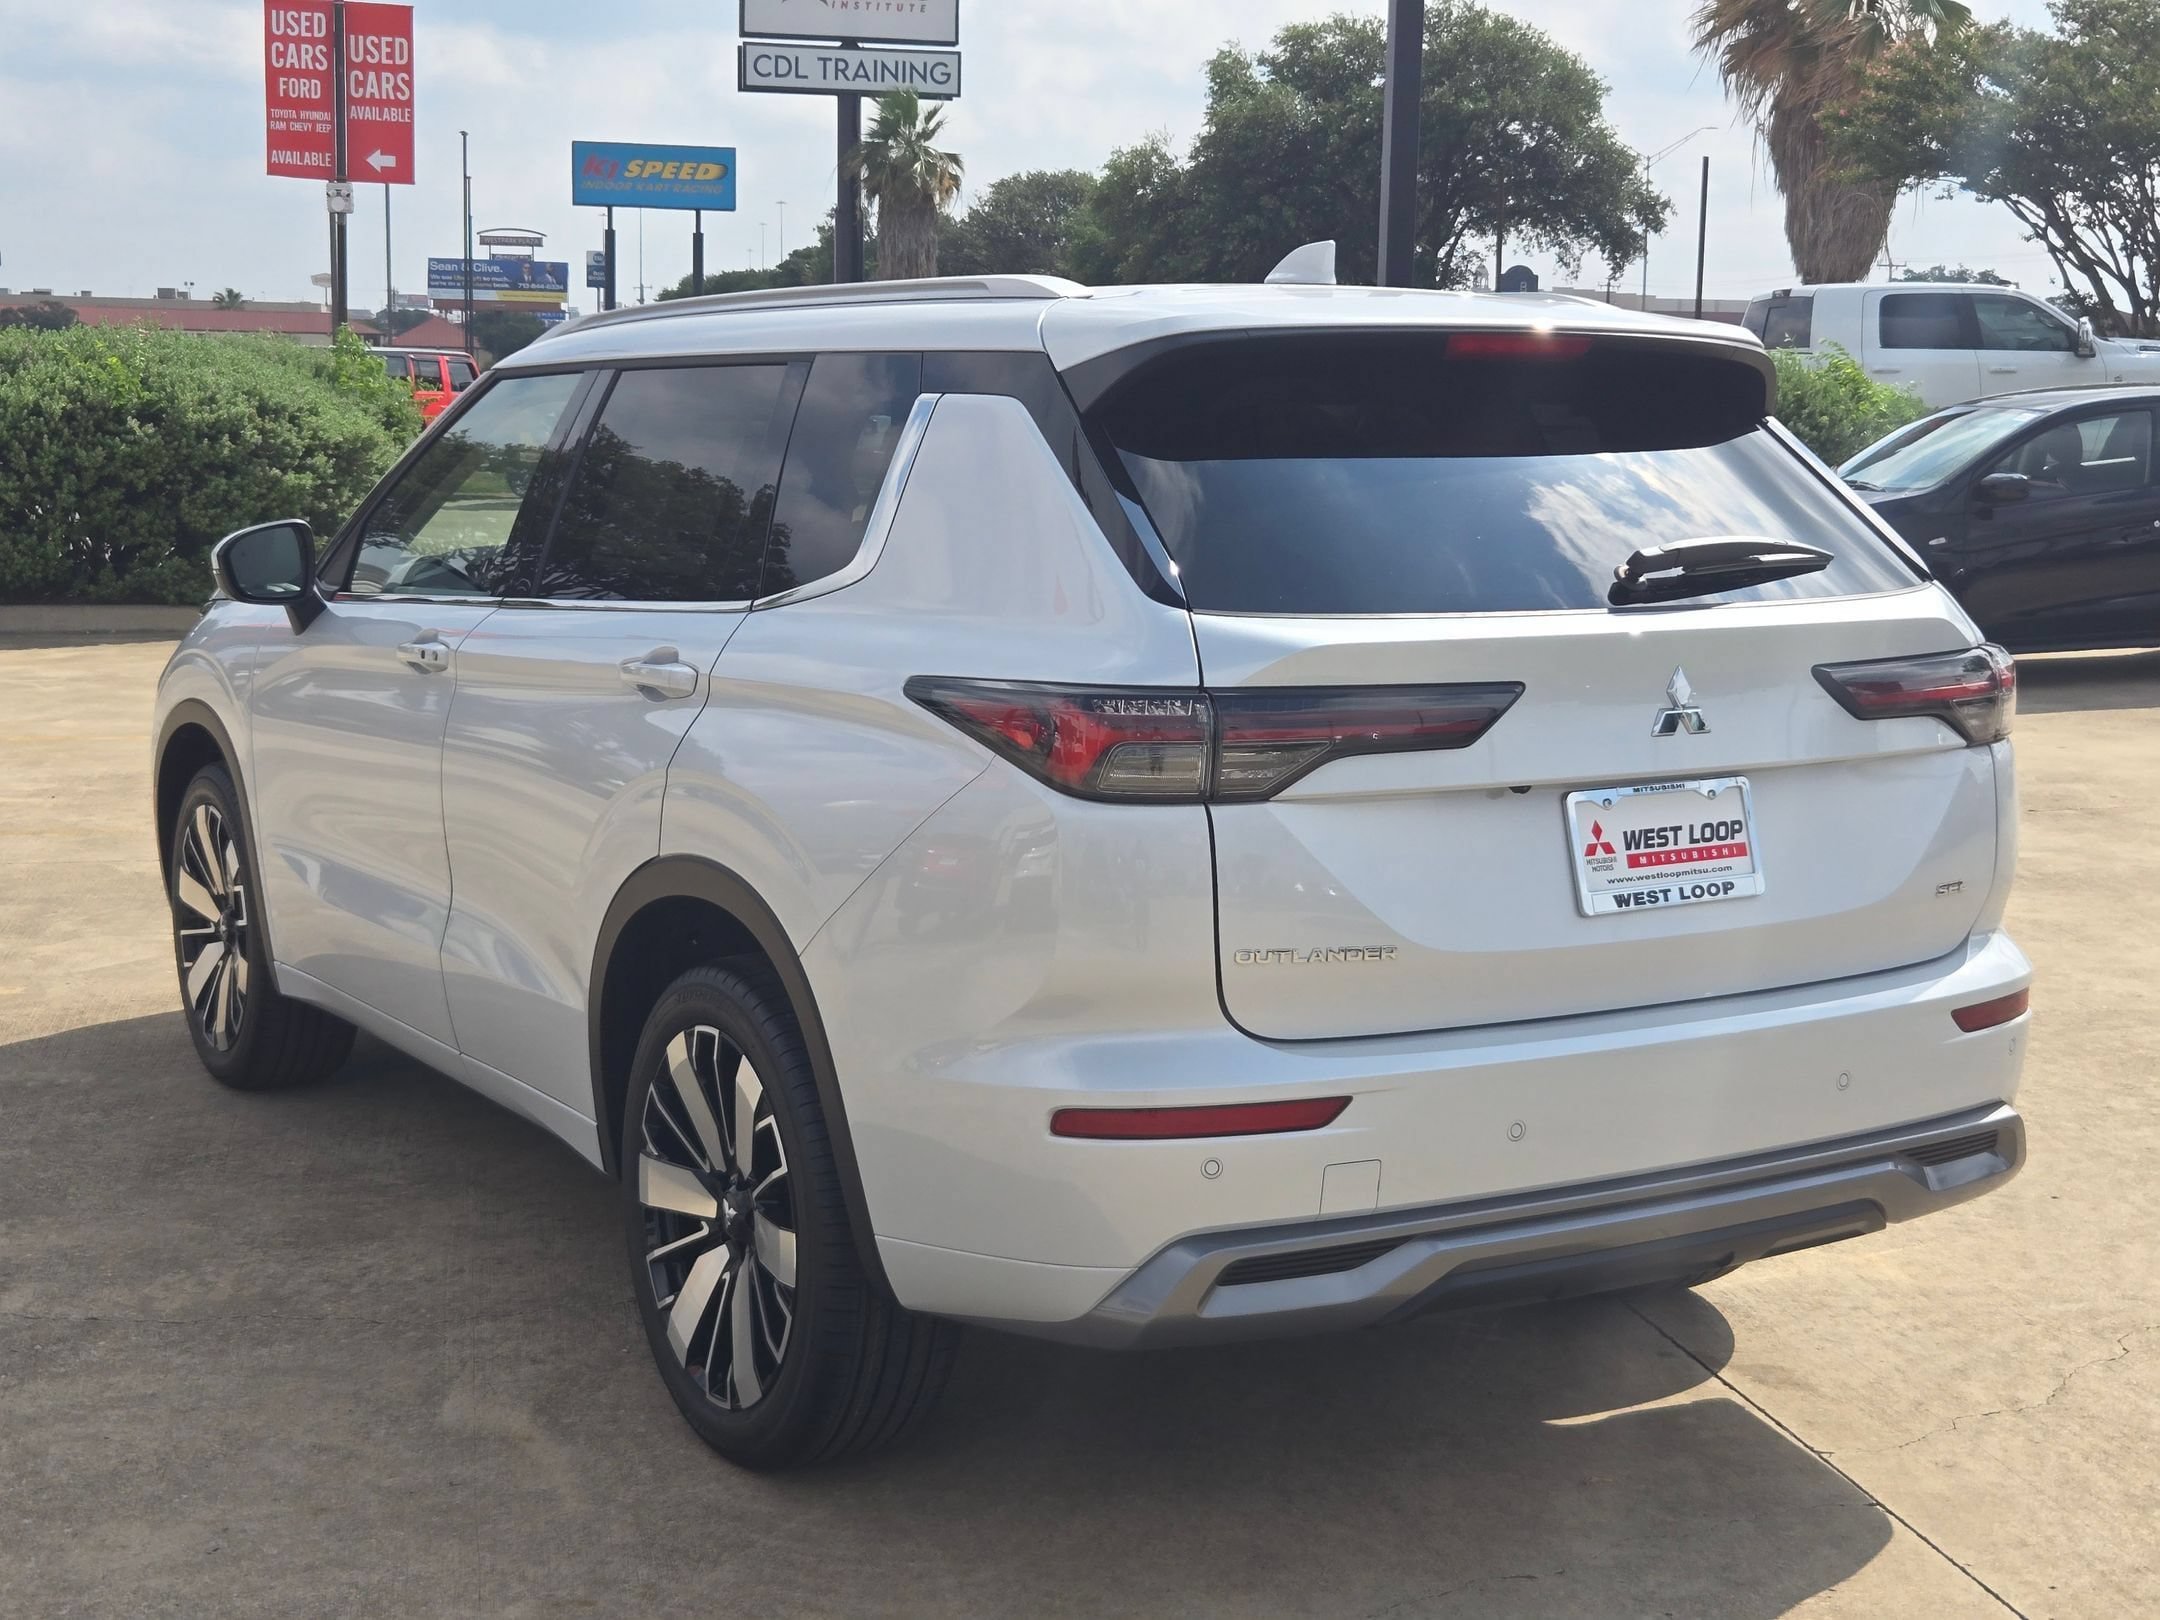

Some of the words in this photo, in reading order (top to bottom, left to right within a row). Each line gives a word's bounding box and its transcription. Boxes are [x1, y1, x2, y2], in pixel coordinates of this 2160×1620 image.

[831, 1, 927, 13] INSTITUTE
[271, 10, 327, 38] USED
[271, 42, 328, 71] CARS
[349, 34, 409, 65] USED
[753, 54, 808, 80] CDL
[817, 57, 952, 85] TRAINING
[280, 78, 321, 99] FORD
[350, 70, 411, 101] CARS
[270, 109, 297, 119] TOYOTA
[300, 110, 331, 121] HYUNDAI
[350, 105, 411, 123] AVAILABLE
[270, 121, 287, 130] RAM
[290, 121, 313, 132] CHEVY
[316, 123, 332, 133] JEEP
[271, 150, 332, 167] AVAILABLE
[624, 159, 729, 181] SPEED
[430, 261, 458, 271] Sean
[473, 262, 503, 272] Clive.
[1632, 783, 1686, 793] MITSUBISHI
[1622, 825, 1683, 852] WEST
[1689, 820, 1743, 844] LOOP
[1639, 846, 1738, 865] MITSUBISHI
[1591, 864, 1615, 872] MOTORS
[1606, 865, 1733, 885] www.westloopmitsu.com
[1613, 889, 1671, 908] WEST
[1680, 881, 1735, 900] LOOP
[1234, 945, 1398, 965] OUTLANDER
